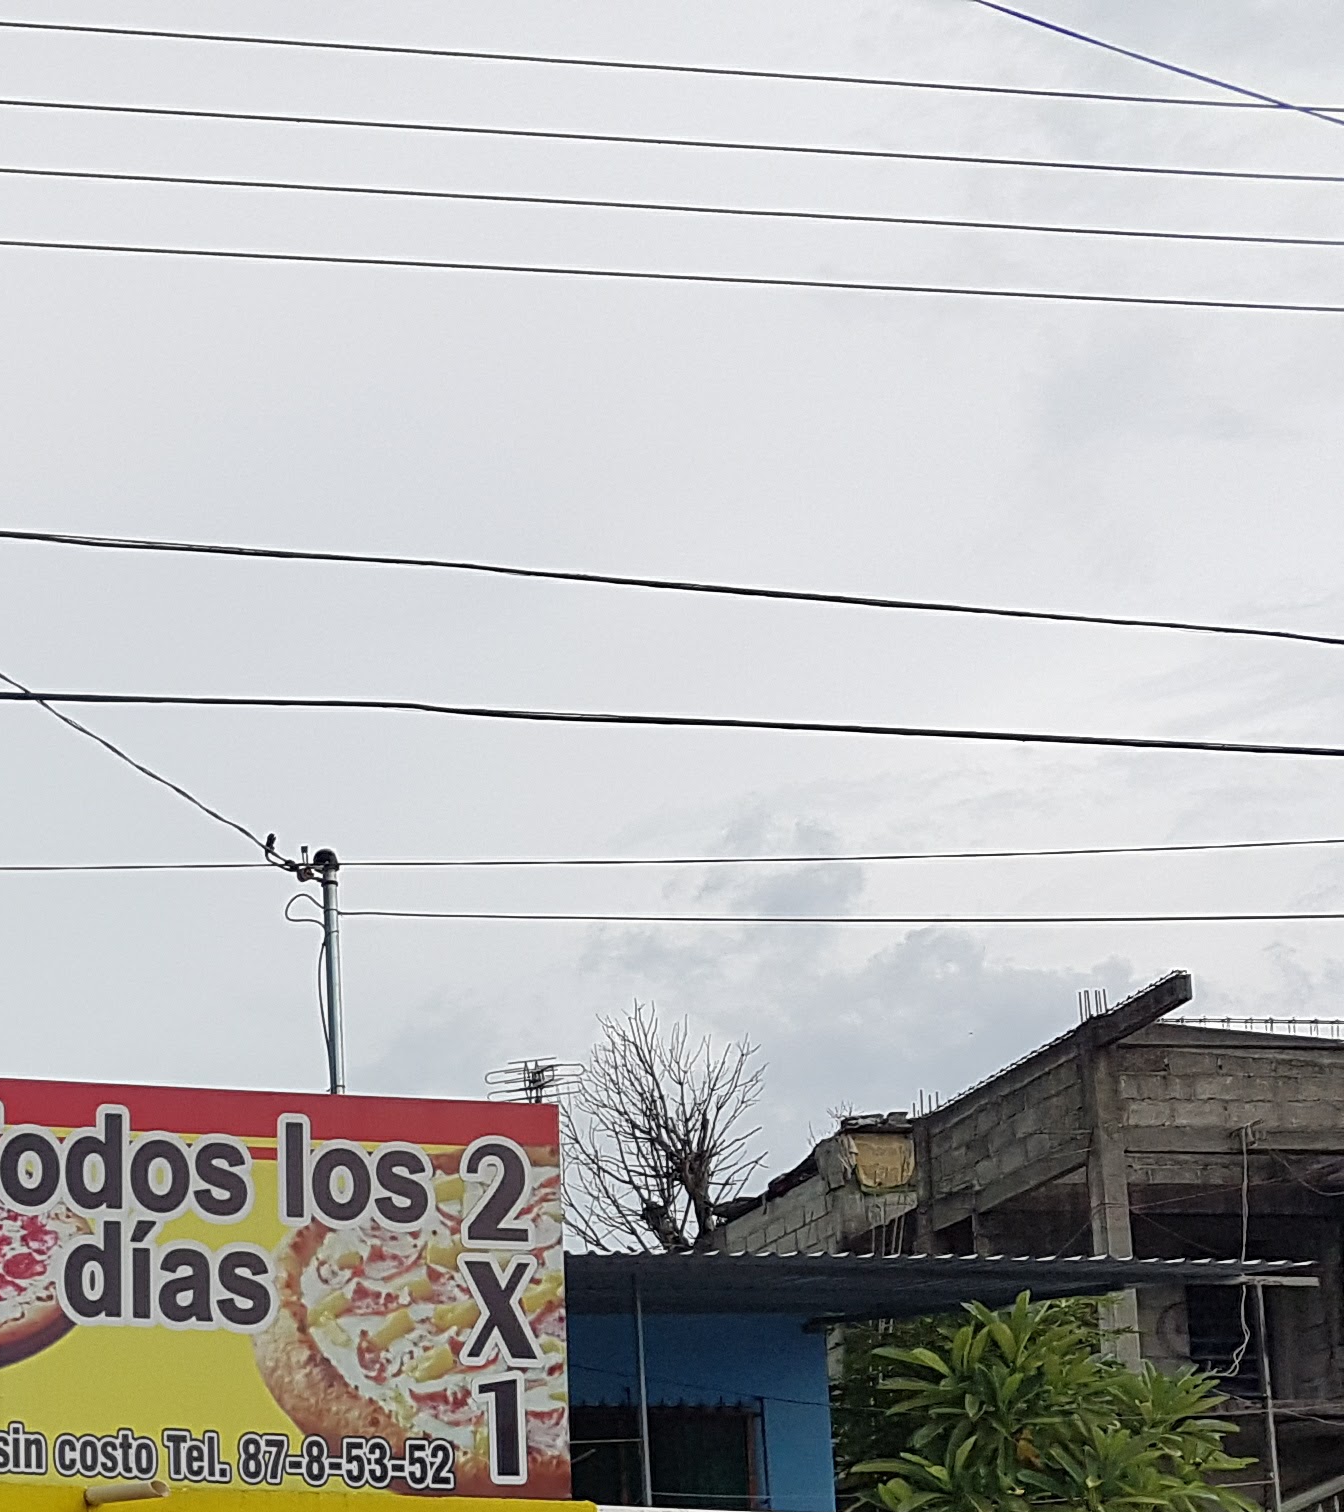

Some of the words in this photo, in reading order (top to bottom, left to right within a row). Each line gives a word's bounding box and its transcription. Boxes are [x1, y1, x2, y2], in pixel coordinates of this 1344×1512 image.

[282, 1119, 433, 1228] los
[461, 1140, 533, 1246] 2
[60, 1217, 274, 1327] días
[462, 1258, 541, 1364] X
[54, 1429, 158, 1482] costo
[164, 1430, 231, 1485] Tel.
[238, 1436, 456, 1491] 87-8-53-52
[474, 1376, 525, 1481] 1
